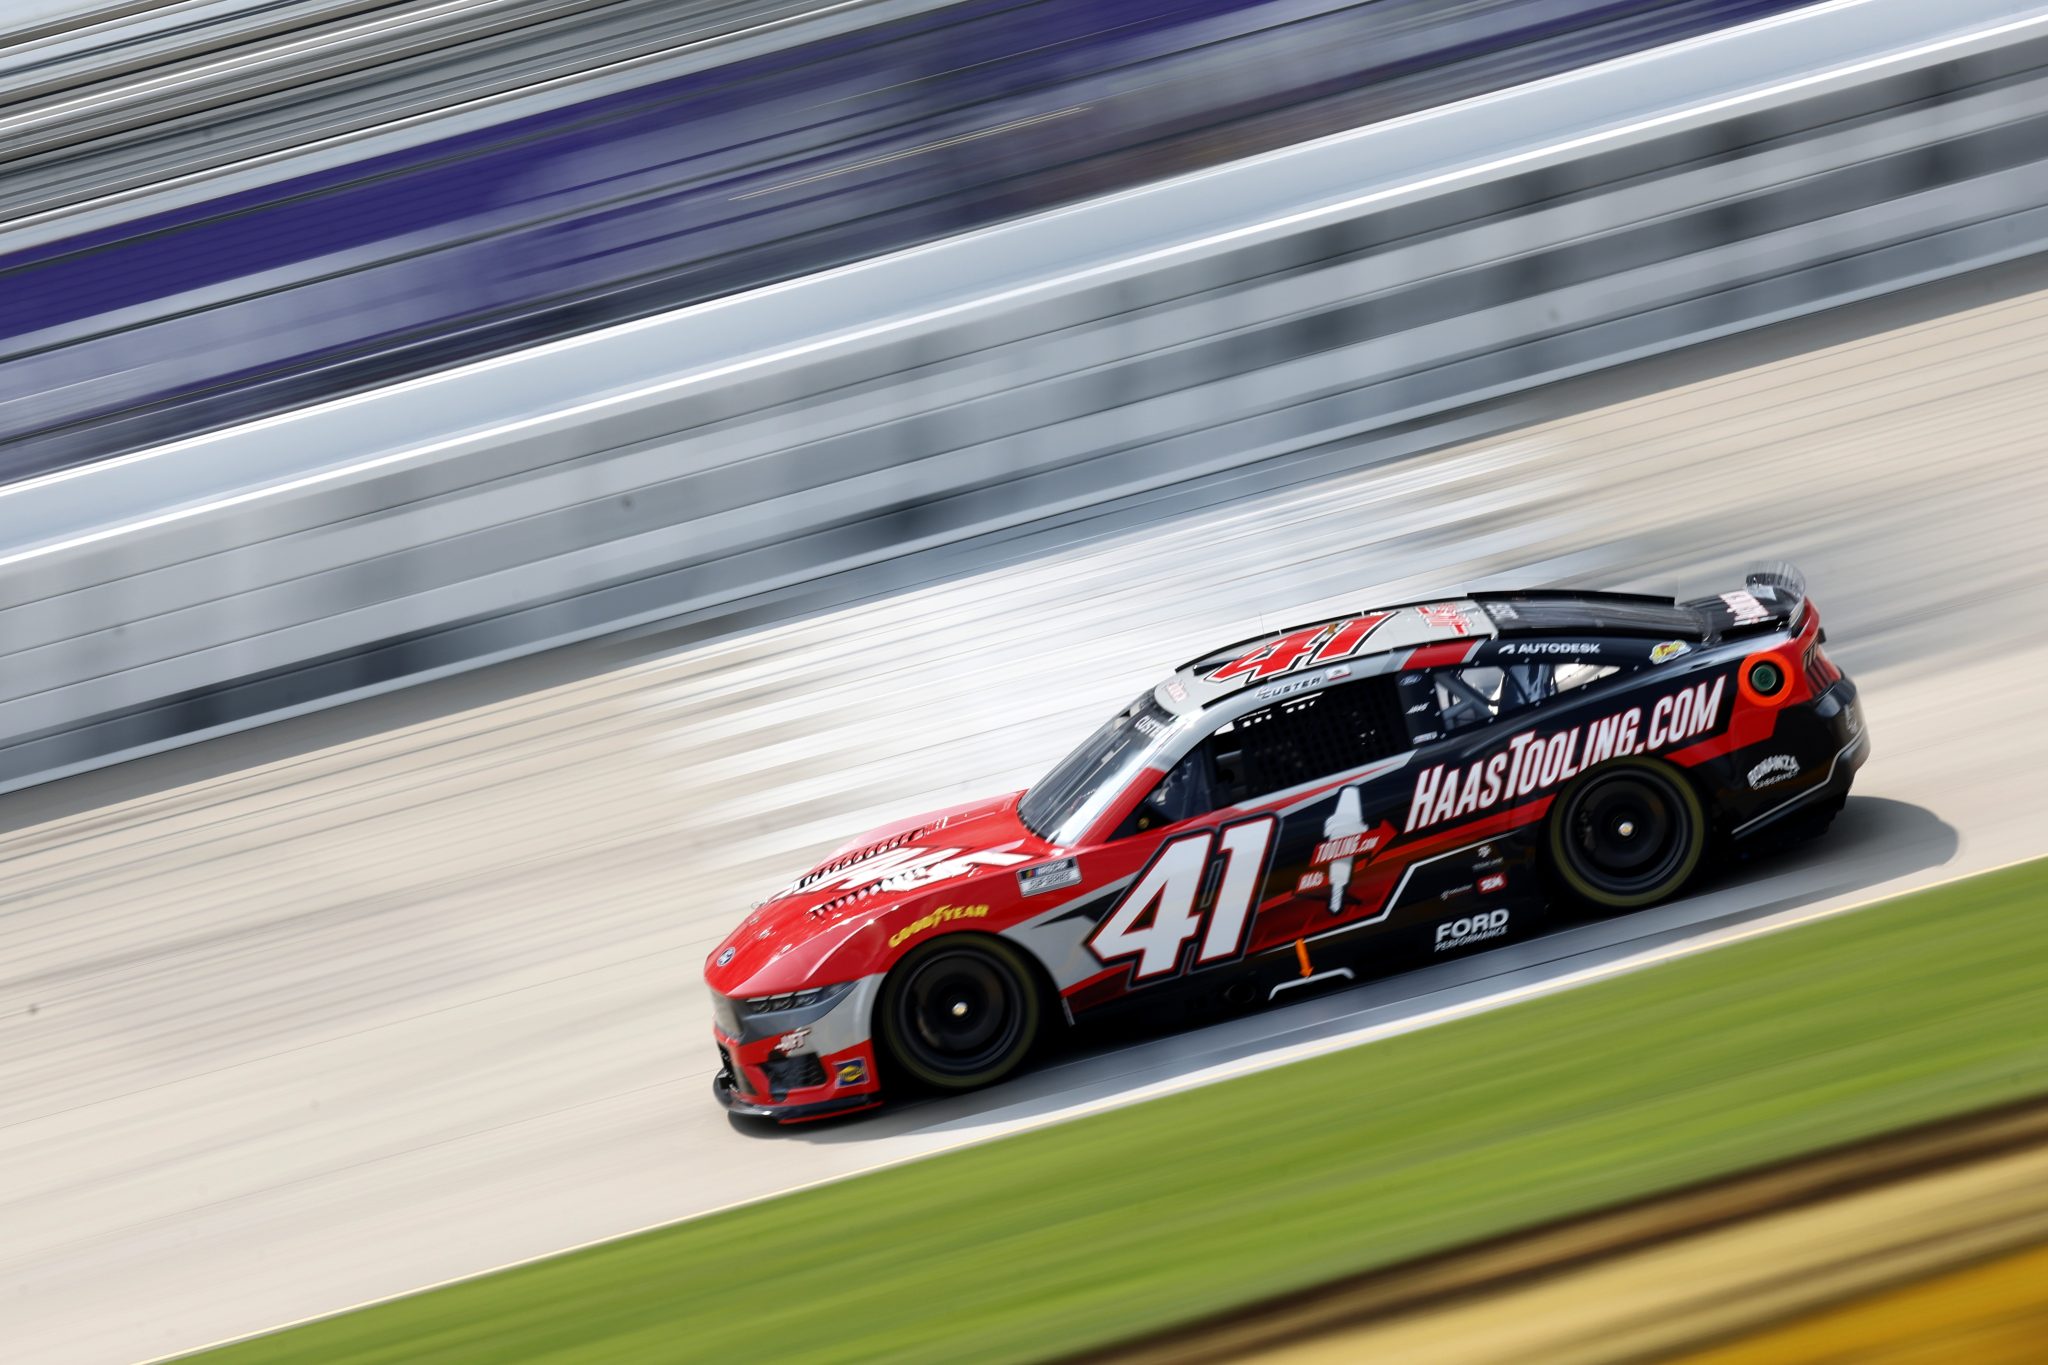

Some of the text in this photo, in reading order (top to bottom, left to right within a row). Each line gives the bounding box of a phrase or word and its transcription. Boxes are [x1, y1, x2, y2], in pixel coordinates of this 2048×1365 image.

[1203, 611, 1399, 685] 41
[1518, 643, 1600, 654] AUTODESK
[1260, 677, 1321, 699] CUSTER
[1747, 755, 1800, 787] BONANZA
[1087, 815, 1276, 981] 41
[888, 904, 989, 948] GOODYEAR
[1434, 925, 1508, 952] PERFORMANCE
[1435, 908, 1509, 943] FORD
